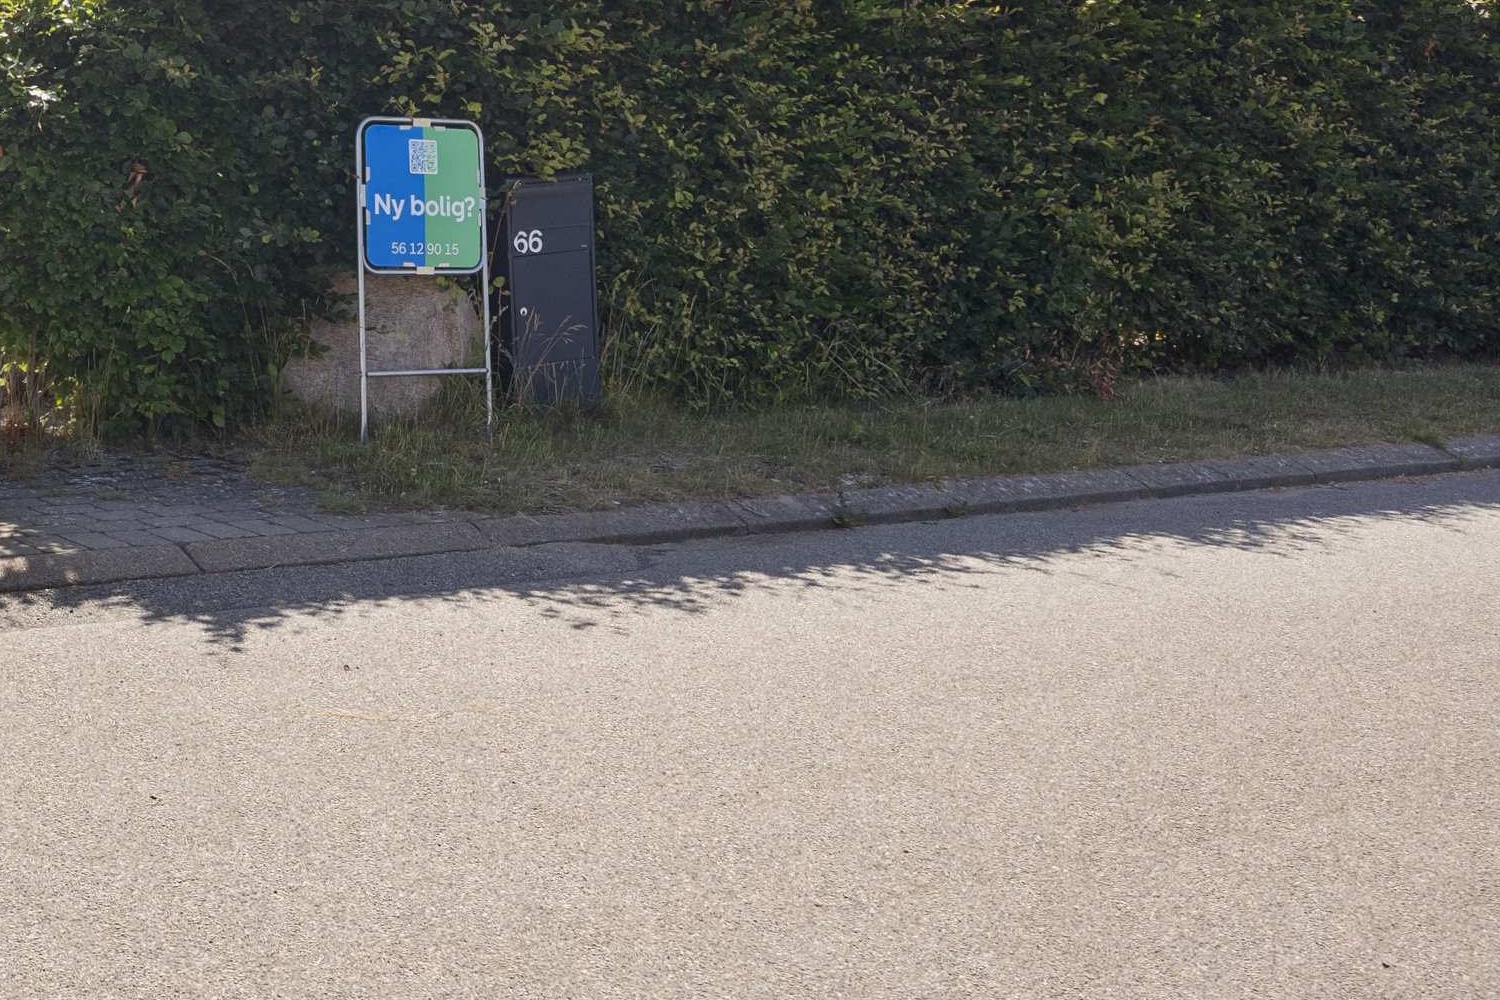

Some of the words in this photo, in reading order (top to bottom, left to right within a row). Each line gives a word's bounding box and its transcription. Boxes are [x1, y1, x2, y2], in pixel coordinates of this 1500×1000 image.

[374, 193, 405, 221] Ny
[410, 194, 476, 222] bolig?
[391, 241, 407, 255] 56
[409, 242, 425, 255] 12
[426, 242, 442, 255] 90
[444, 243, 460, 256] 15
[513, 229, 544, 254] 66
